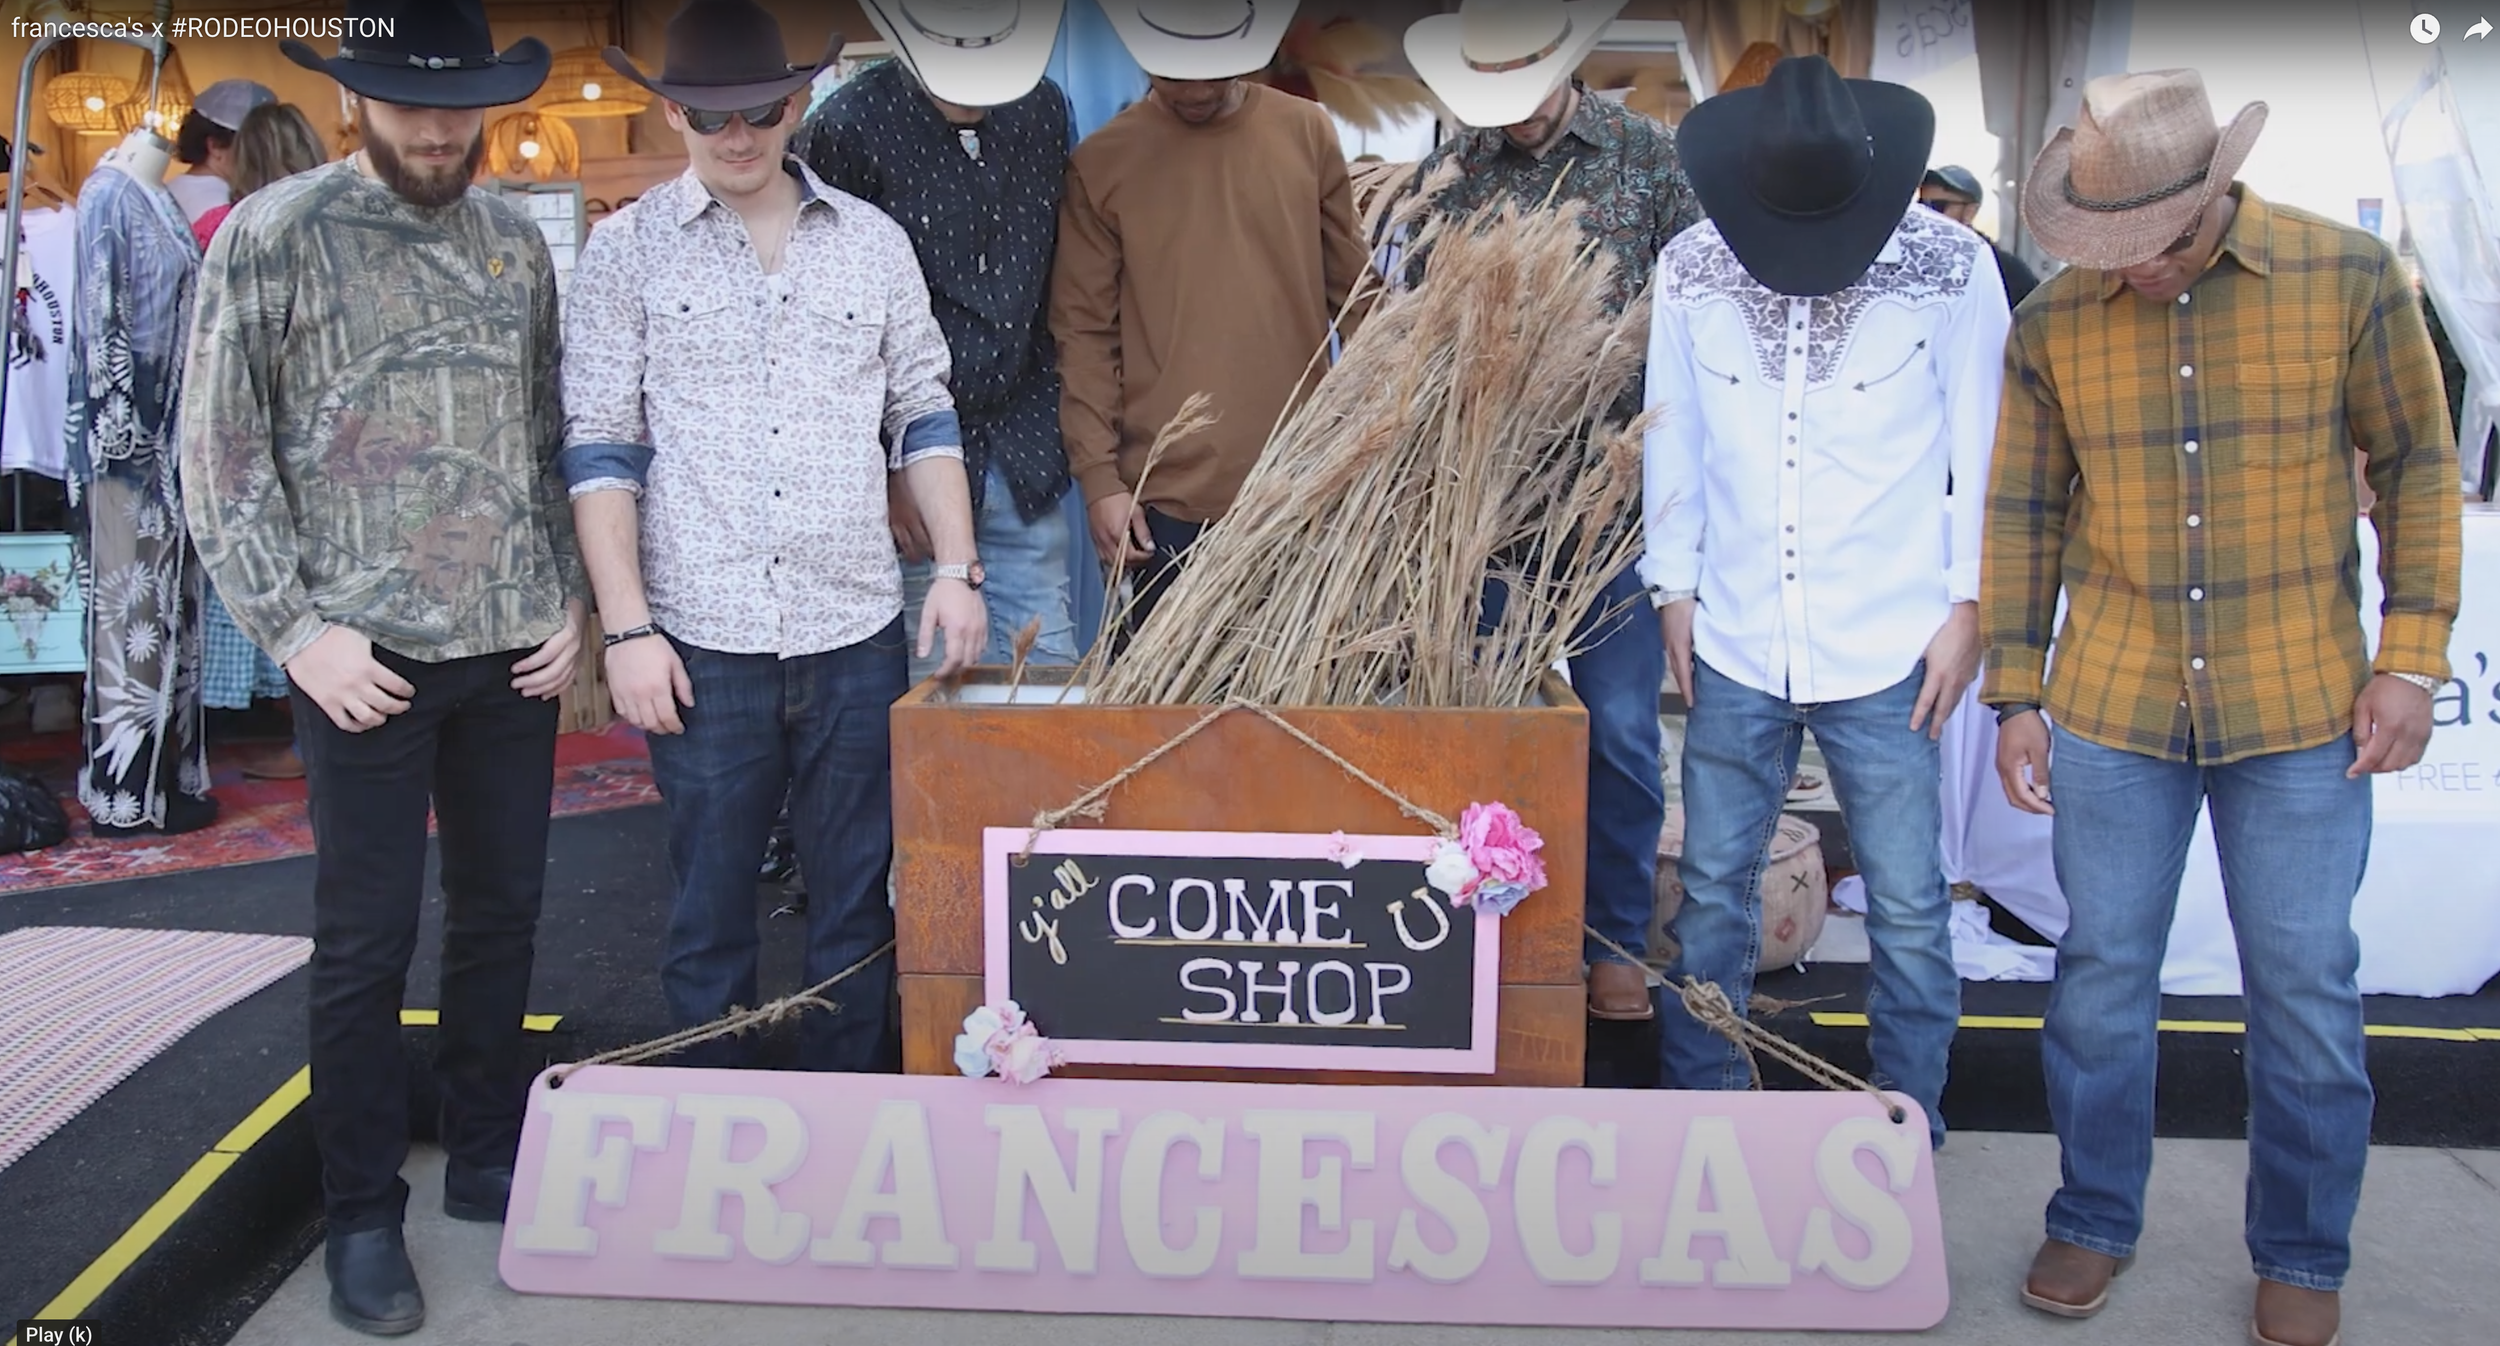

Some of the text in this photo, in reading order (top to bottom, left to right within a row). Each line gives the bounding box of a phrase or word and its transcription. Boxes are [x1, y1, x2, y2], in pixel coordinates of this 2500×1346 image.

[2398, 762, 2483, 791] FREE
[1019, 858, 1100, 965] y'all
[1107, 873, 1354, 944] COME
[1178, 957, 1412, 1026] SHOP
[513, 1092, 1919, 1291] FRANCESCAS
